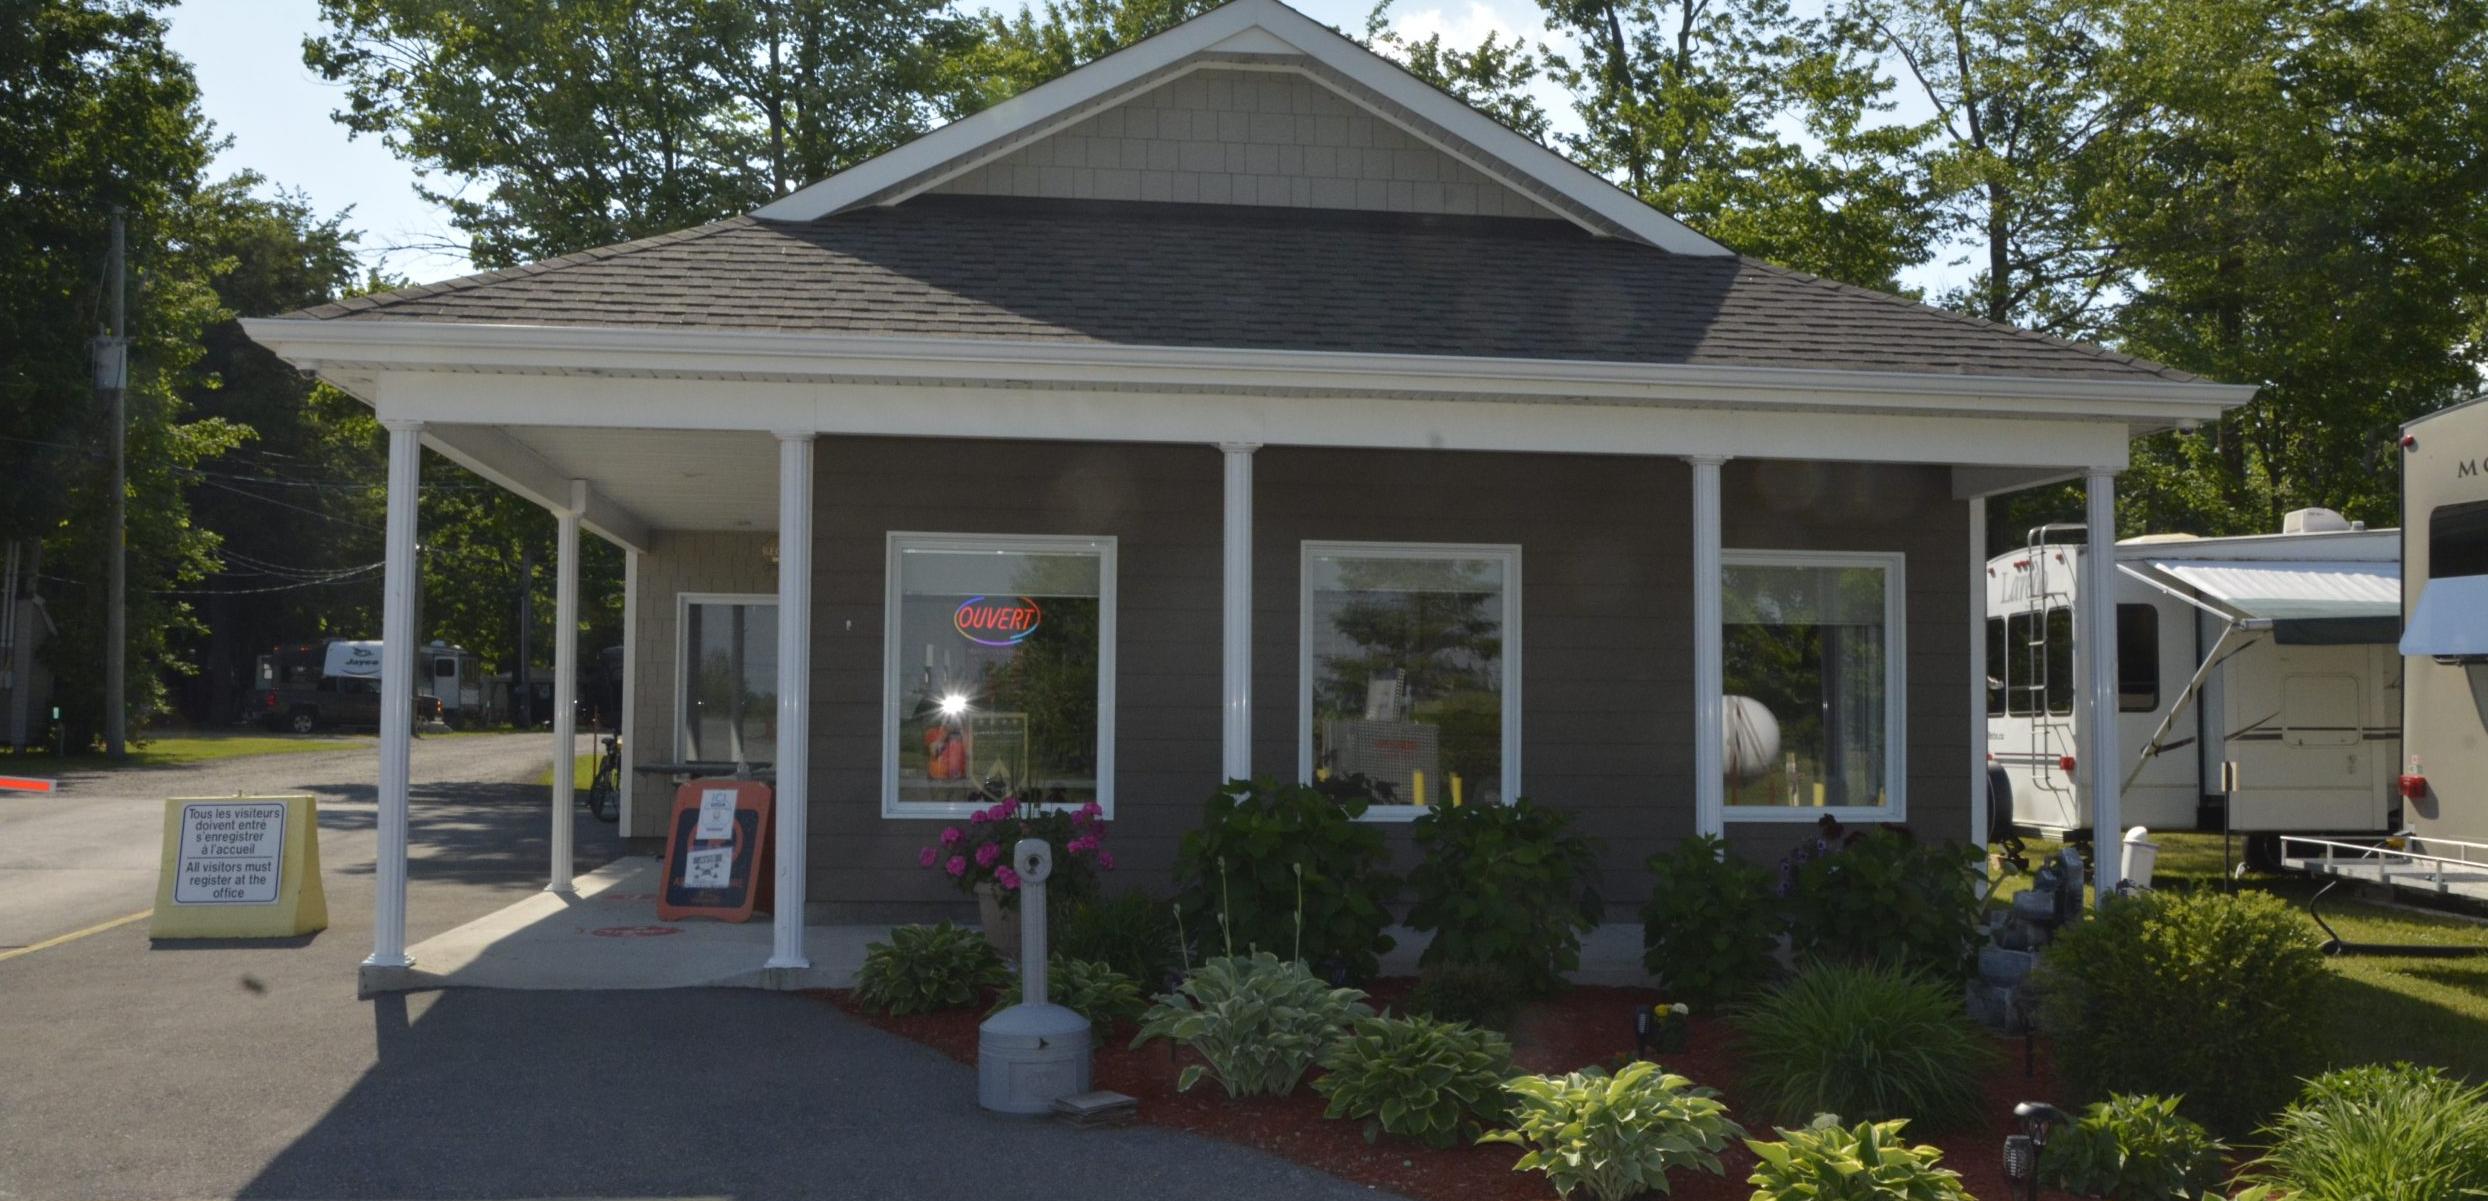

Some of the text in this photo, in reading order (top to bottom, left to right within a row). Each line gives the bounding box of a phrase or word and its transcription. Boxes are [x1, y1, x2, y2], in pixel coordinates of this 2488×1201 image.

[2458, 457, 2488, 478] M
[959, 606, 1035, 630] OUVERT
[345, 658, 379, 666] Jayco
[189, 807, 280, 819] Tous les visiteurs
[195, 820, 235, 831] doivent
[196, 831, 264, 844] s'enregistrer
[201, 843, 255, 855] à l'accueil
[186, 861, 272, 873] All visitors must
[189, 874, 267, 888] register at the
[213, 887, 245, 898] office
